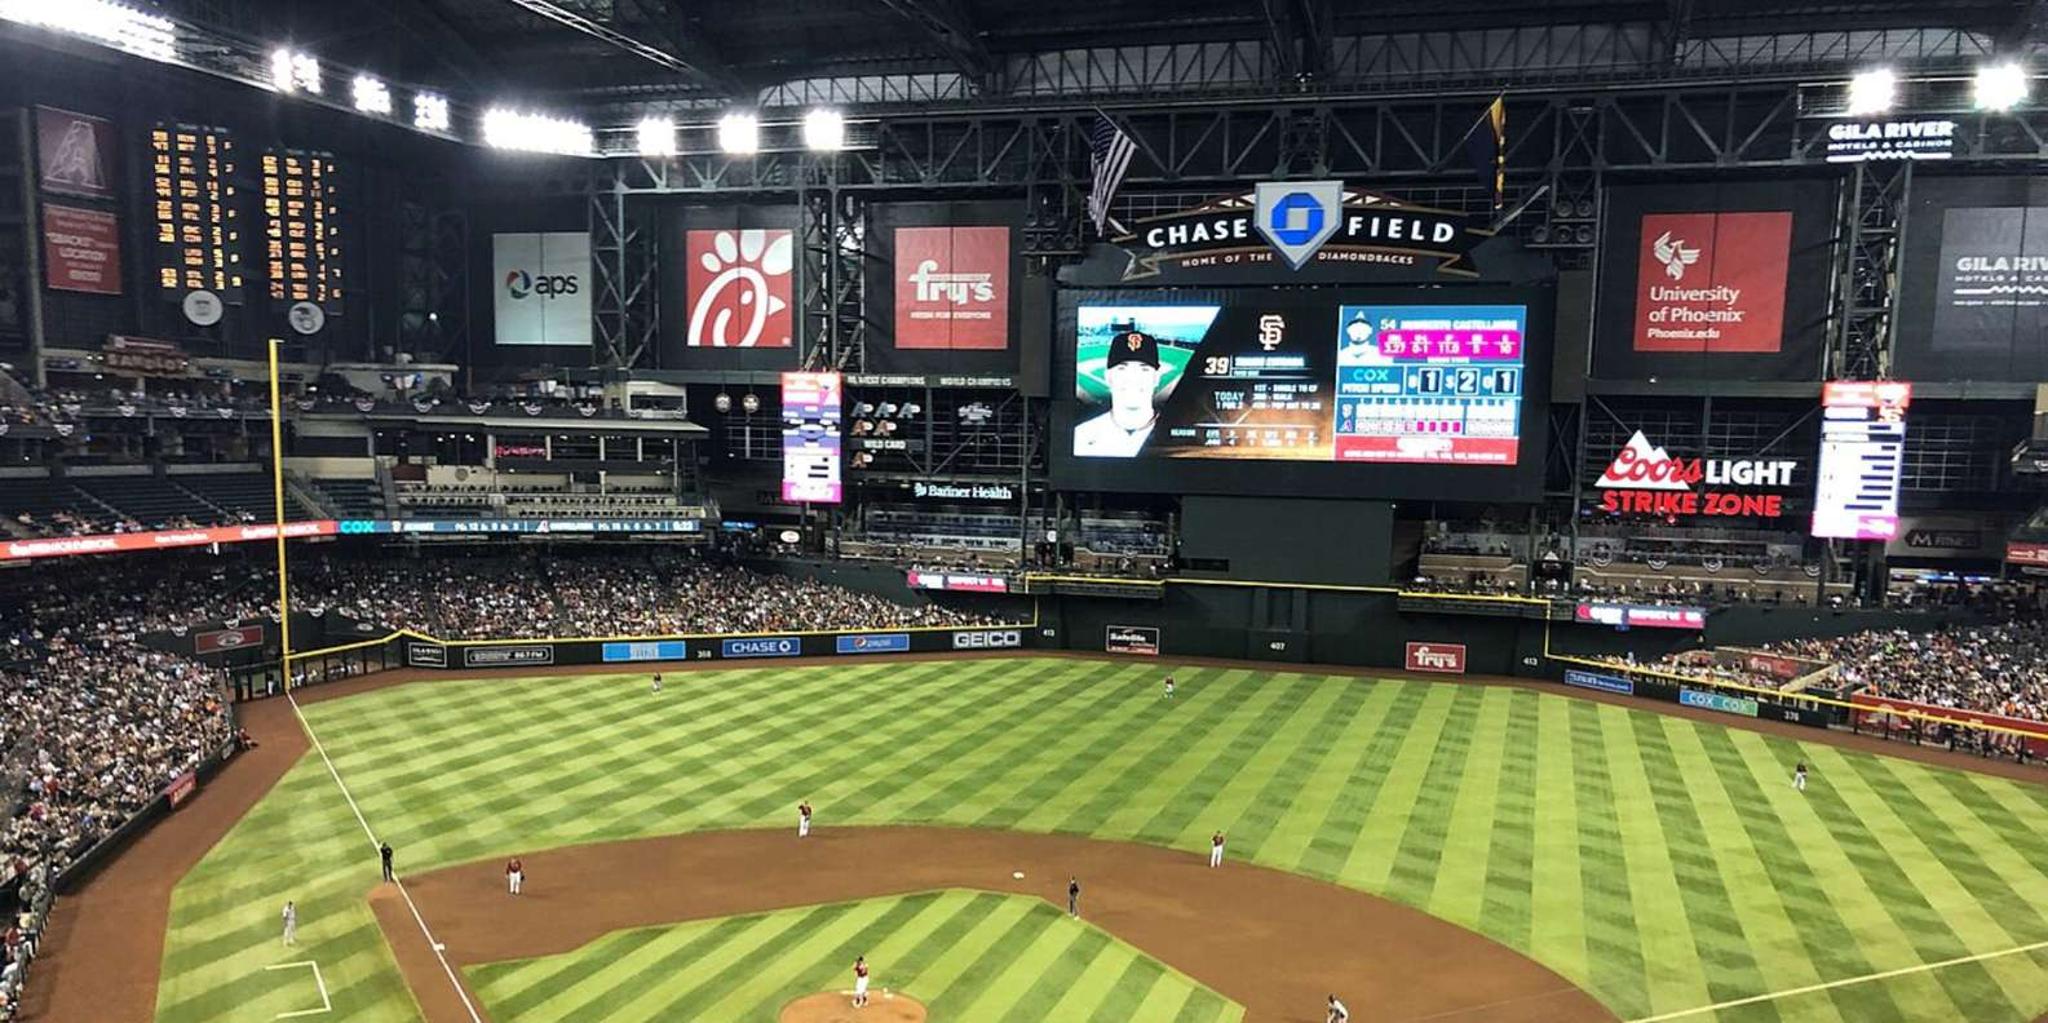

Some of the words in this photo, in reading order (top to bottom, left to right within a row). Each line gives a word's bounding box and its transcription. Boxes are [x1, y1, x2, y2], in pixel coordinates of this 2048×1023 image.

[1829, 123, 1882, 140] GILA
[1885, 121, 1953, 138] RIVER
[1827, 142, 1877, 150] HOTELS
[1895, 140, 1952, 148] CASINOS
[1147, 218, 1247, 248] CHASE
[1349, 217, 1455, 243] FIELD
[1182, 258, 1216, 266] HOME
[1224, 254, 1240, 263] OF
[1250, 252, 1272, 262] THE
[1318, 252, 1414, 265] DIAMONDBACKS
[1956, 256, 2010, 271] GILA
[535, 274, 578, 299] aps
[1650, 286, 1740, 305] University
[1648, 306, 1670, 322] of
[1671, 306, 1743, 322] Phoenix
[1648, 327, 1720, 339] Phoenix.edu
[1204, 357, 1229, 375] 39
[1353, 369, 1389, 381] COX
[1424, 372, 1437, 391] 1
[1460, 372, 1475, 391] 2
[1499, 372, 1511, 391] 1
[1215, 391, 1244, 401] TODAY
[885, 440, 906, 449] CARD
[1606, 447, 1703, 482] Coors
[1705, 460, 1797, 485] LIGHT
[972, 486, 1012, 499] Health
[1603, 491, 1698, 515] STRIKE
[1703, 493, 1782, 517] ZONE
[340, 520, 375, 533] COX
[953, 631, 1020, 648] GEICO
[731, 643, 776, 653] CHASE
[1689, 694, 1714, 707] COX
[1722, 699, 1749, 714] COX
